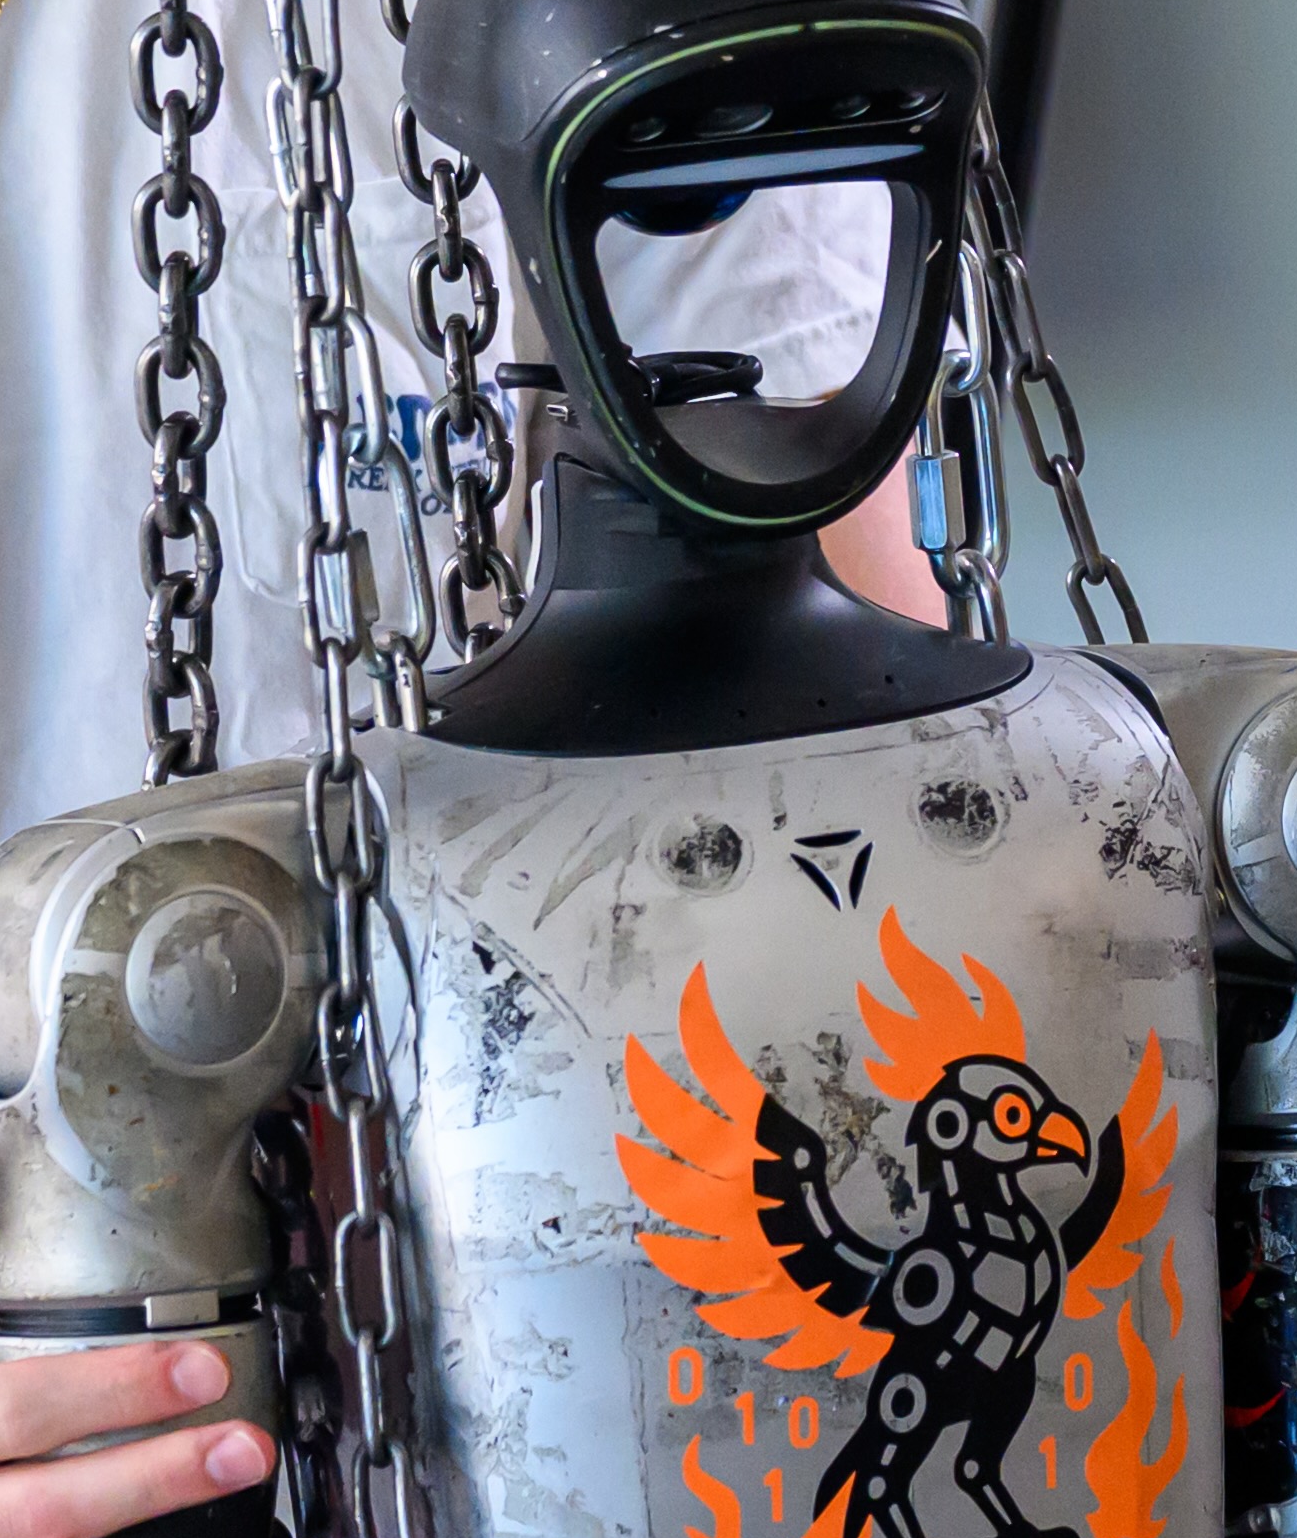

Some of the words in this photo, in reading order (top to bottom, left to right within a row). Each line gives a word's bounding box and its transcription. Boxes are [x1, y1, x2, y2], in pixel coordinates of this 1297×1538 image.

[668, 1346, 704, 1406] 0
[1064, 1352, 1093, 1411] 0
[735, 1391, 755, 1445] 1
[788, 1396, 819, 1449] 0
[1039, 1436, 1057, 1490] 1
[763, 1467, 783, 1523] 1
